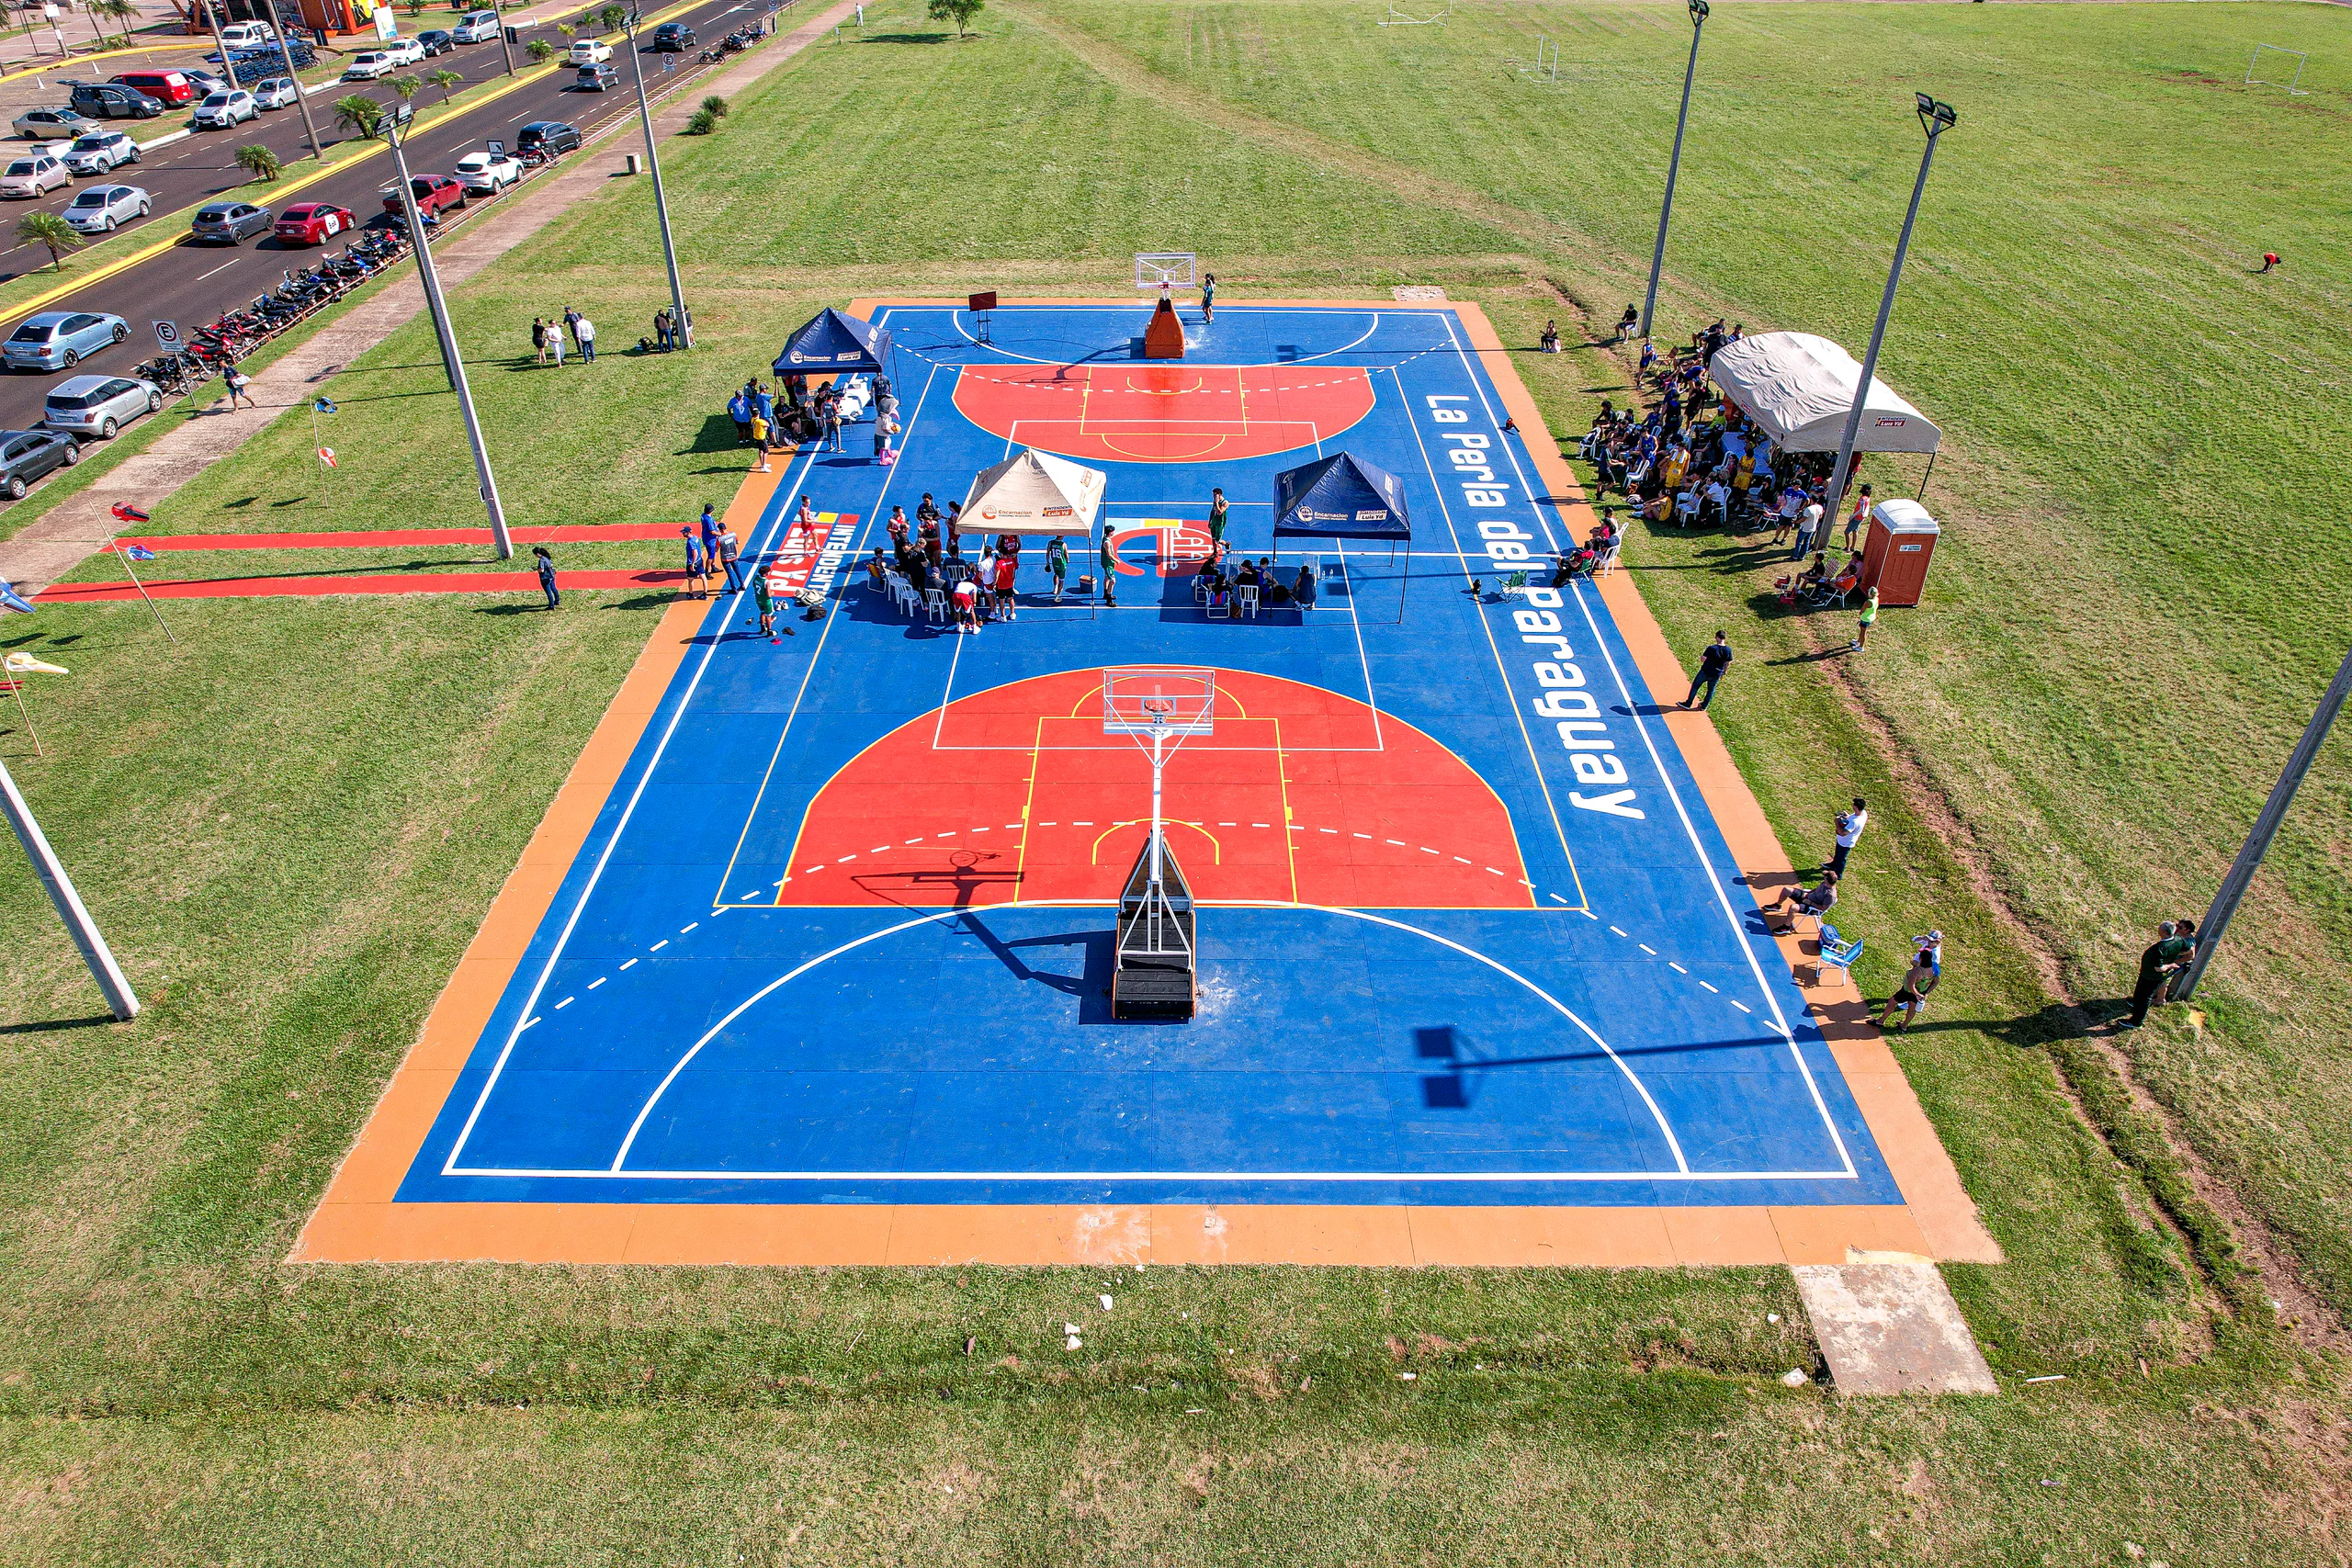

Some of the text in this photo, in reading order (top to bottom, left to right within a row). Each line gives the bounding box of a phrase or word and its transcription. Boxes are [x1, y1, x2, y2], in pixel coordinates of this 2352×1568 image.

[161, 326, 172, 338] E
[808, 524, 856, 596] INTENDENT
[1051, 547, 1062, 558] 16
[768, 569, 808, 592] Yd
[1426, 395, 1646, 820] La Perla del Paraguay
